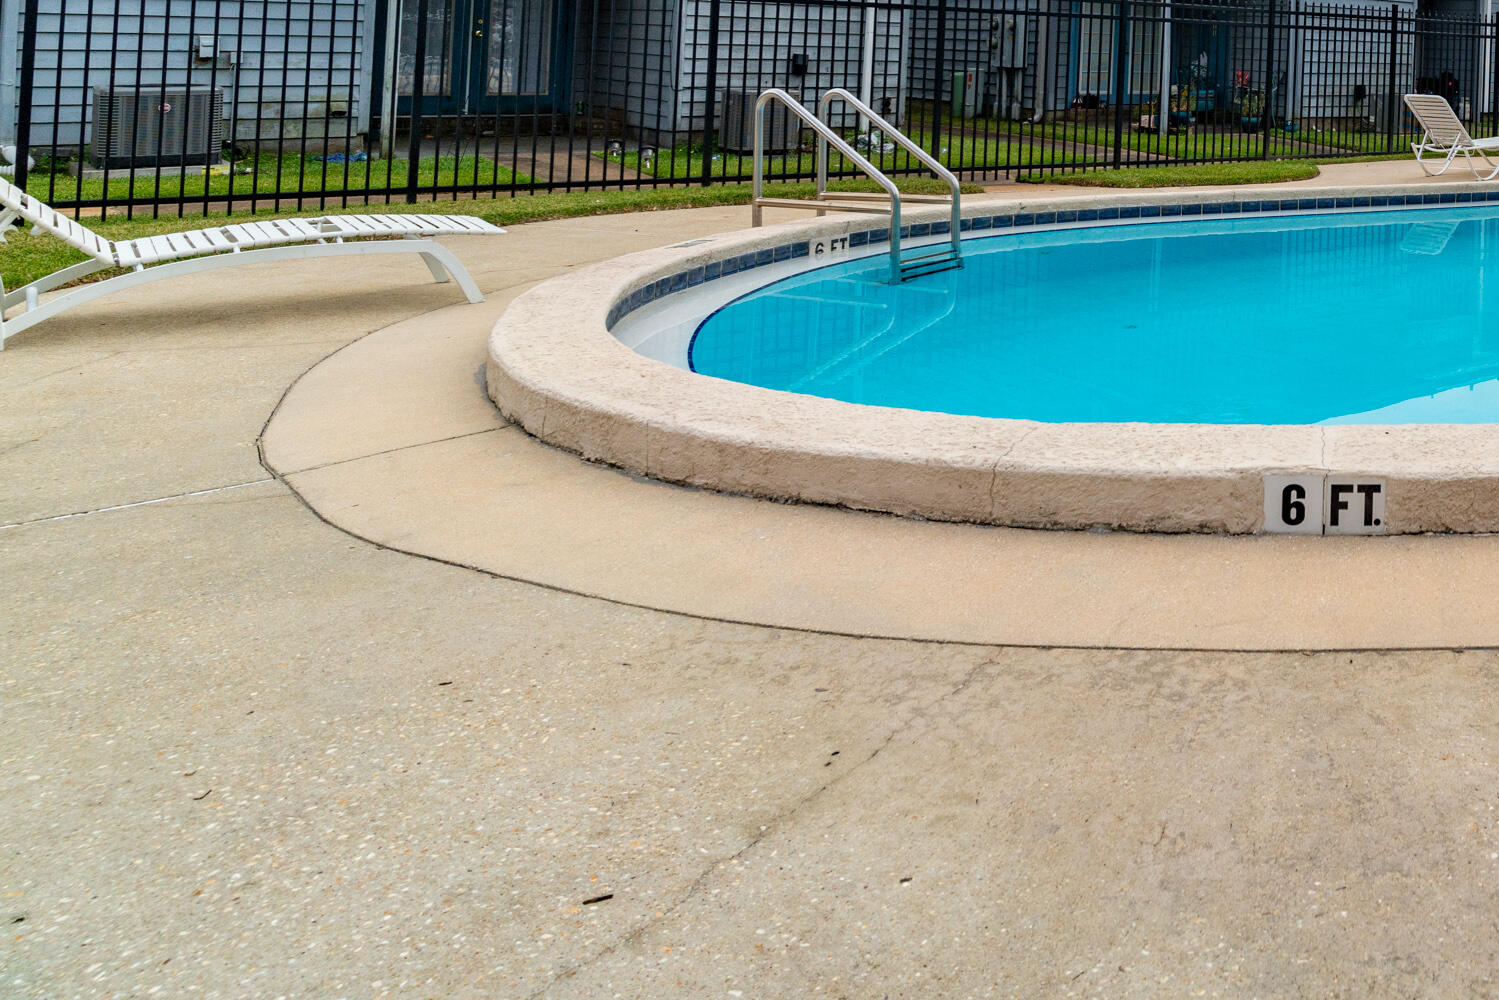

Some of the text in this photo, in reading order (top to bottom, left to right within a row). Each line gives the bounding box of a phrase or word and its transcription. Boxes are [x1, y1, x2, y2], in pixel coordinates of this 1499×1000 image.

[830, 237, 847, 252] FT
[1281, 483, 1381, 526] 6 FT.
